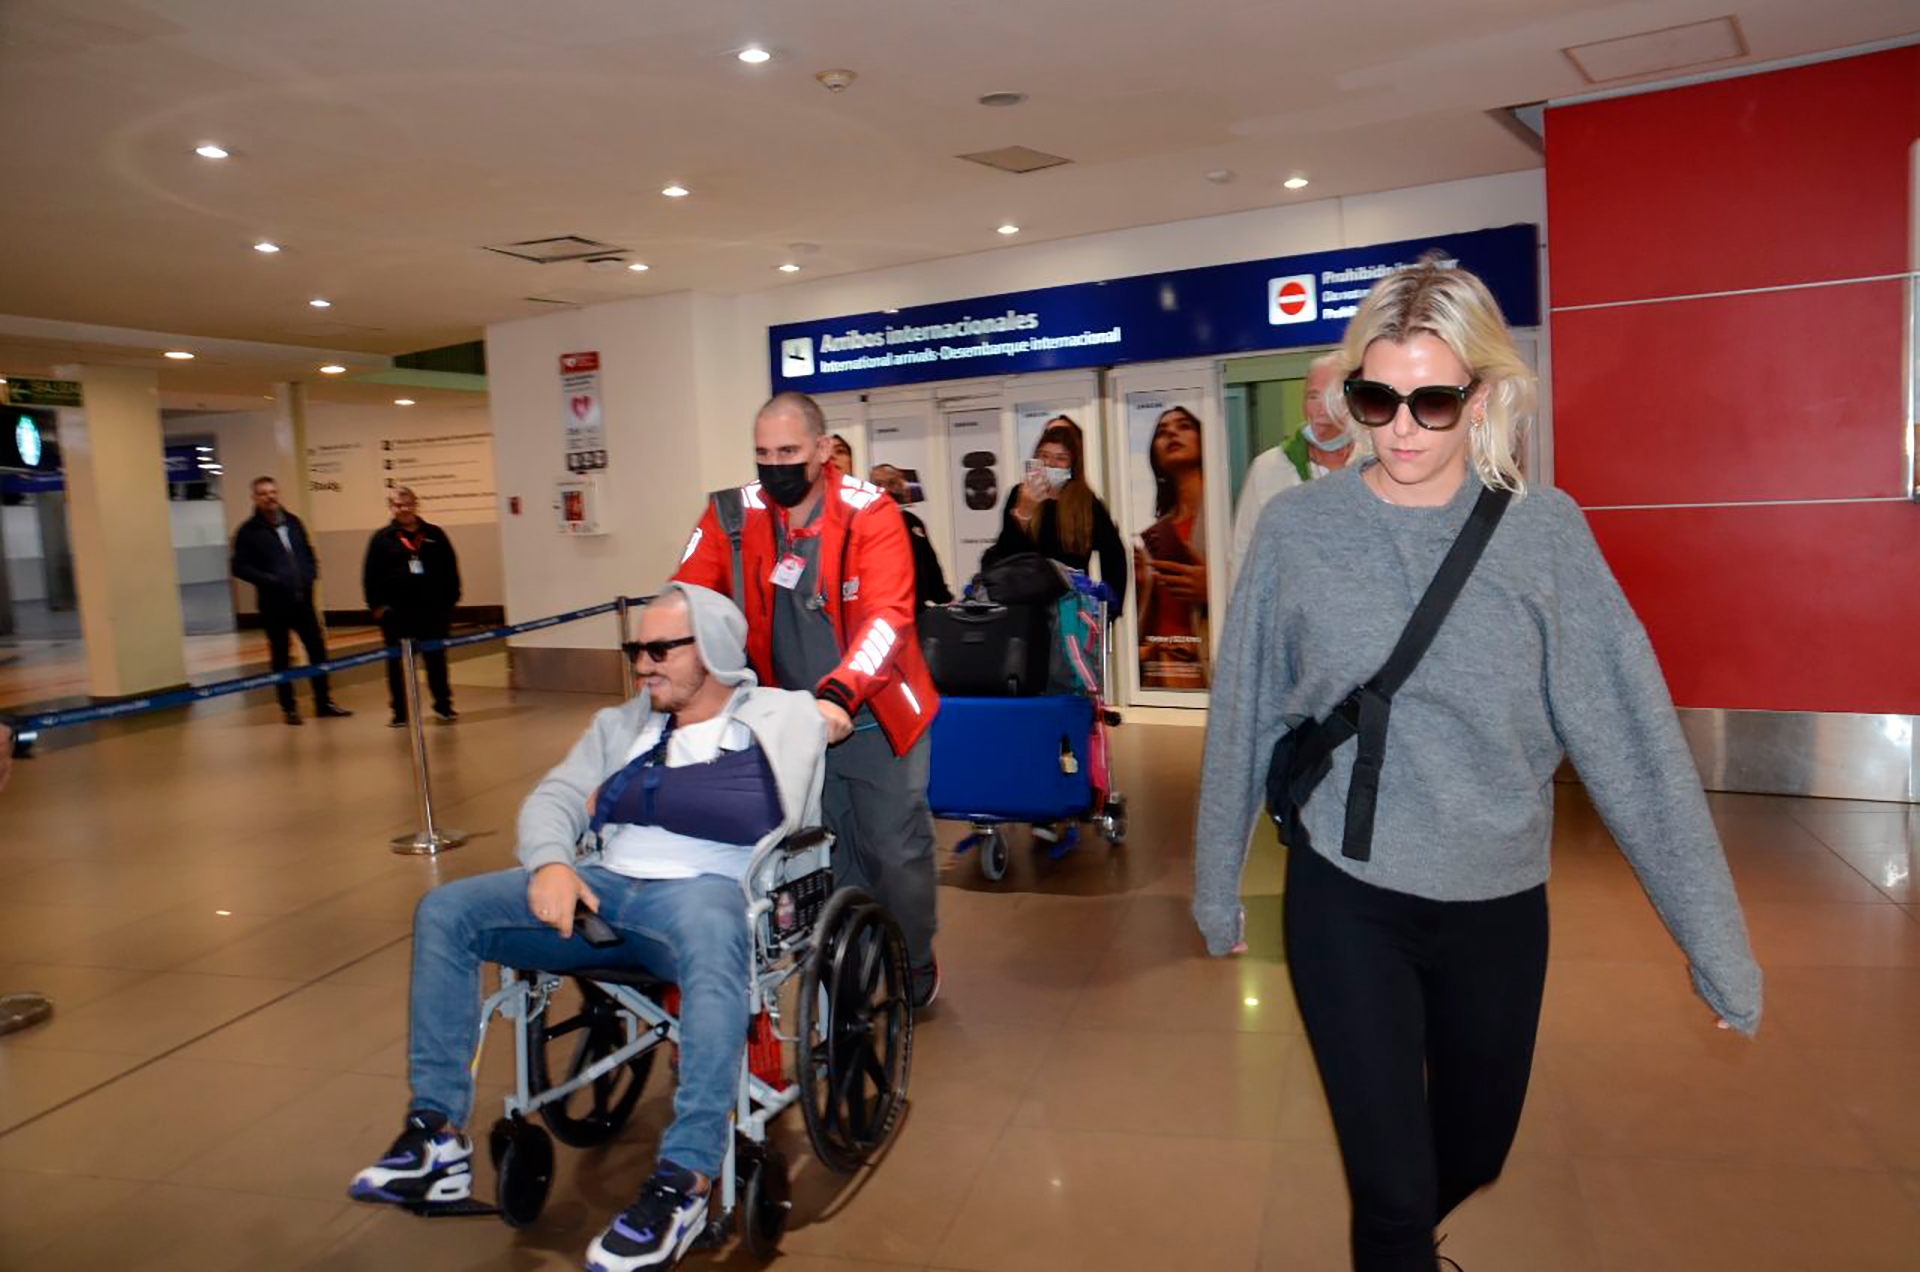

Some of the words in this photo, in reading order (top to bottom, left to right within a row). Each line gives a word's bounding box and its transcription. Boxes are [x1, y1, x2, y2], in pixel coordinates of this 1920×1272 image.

[886, 310, 1039, 345] internacionales
[820, 352, 894, 373] International
[893, 347, 938, 365] arrivals
[940, 341, 1030, 360] Desembarque
[1030, 326, 1122, 350] internacional
